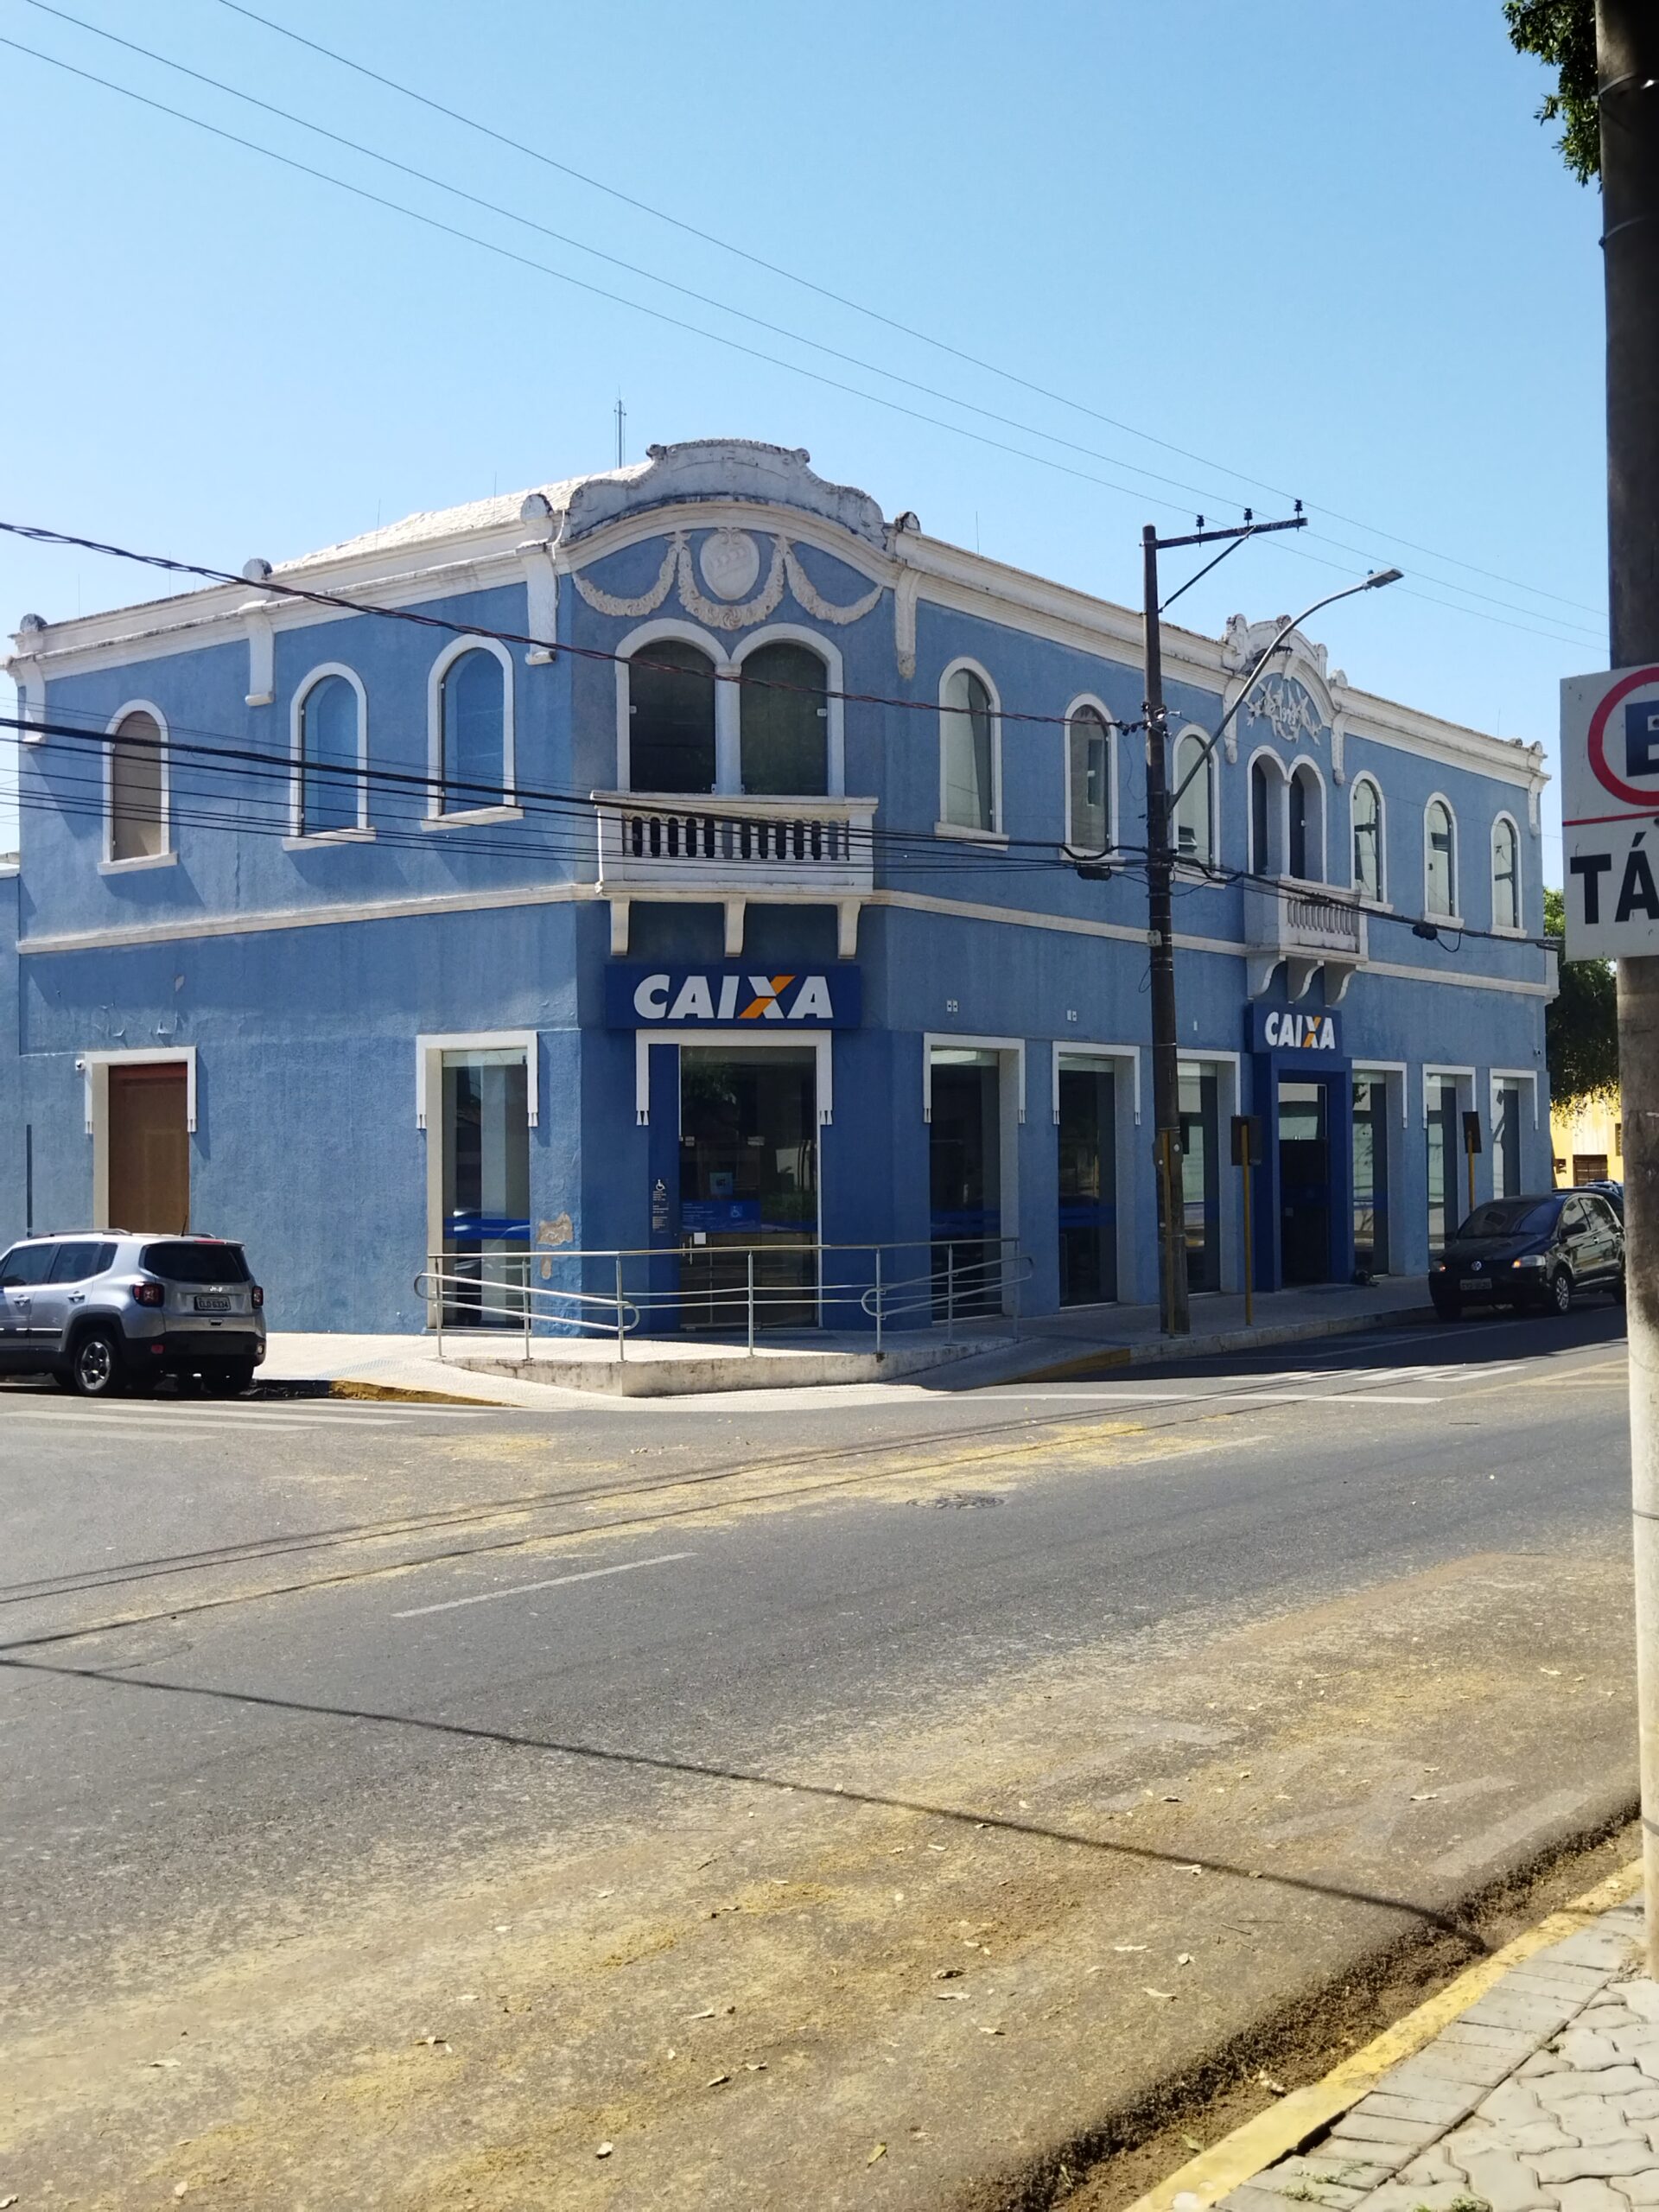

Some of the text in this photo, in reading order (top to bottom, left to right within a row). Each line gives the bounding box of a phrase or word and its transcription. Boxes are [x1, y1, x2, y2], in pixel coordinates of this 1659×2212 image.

[1570, 831, 1659, 925] TÁ
[633, 974, 834, 1020] CAIXA
[1264, 1011, 1336, 1050] CAIXA
